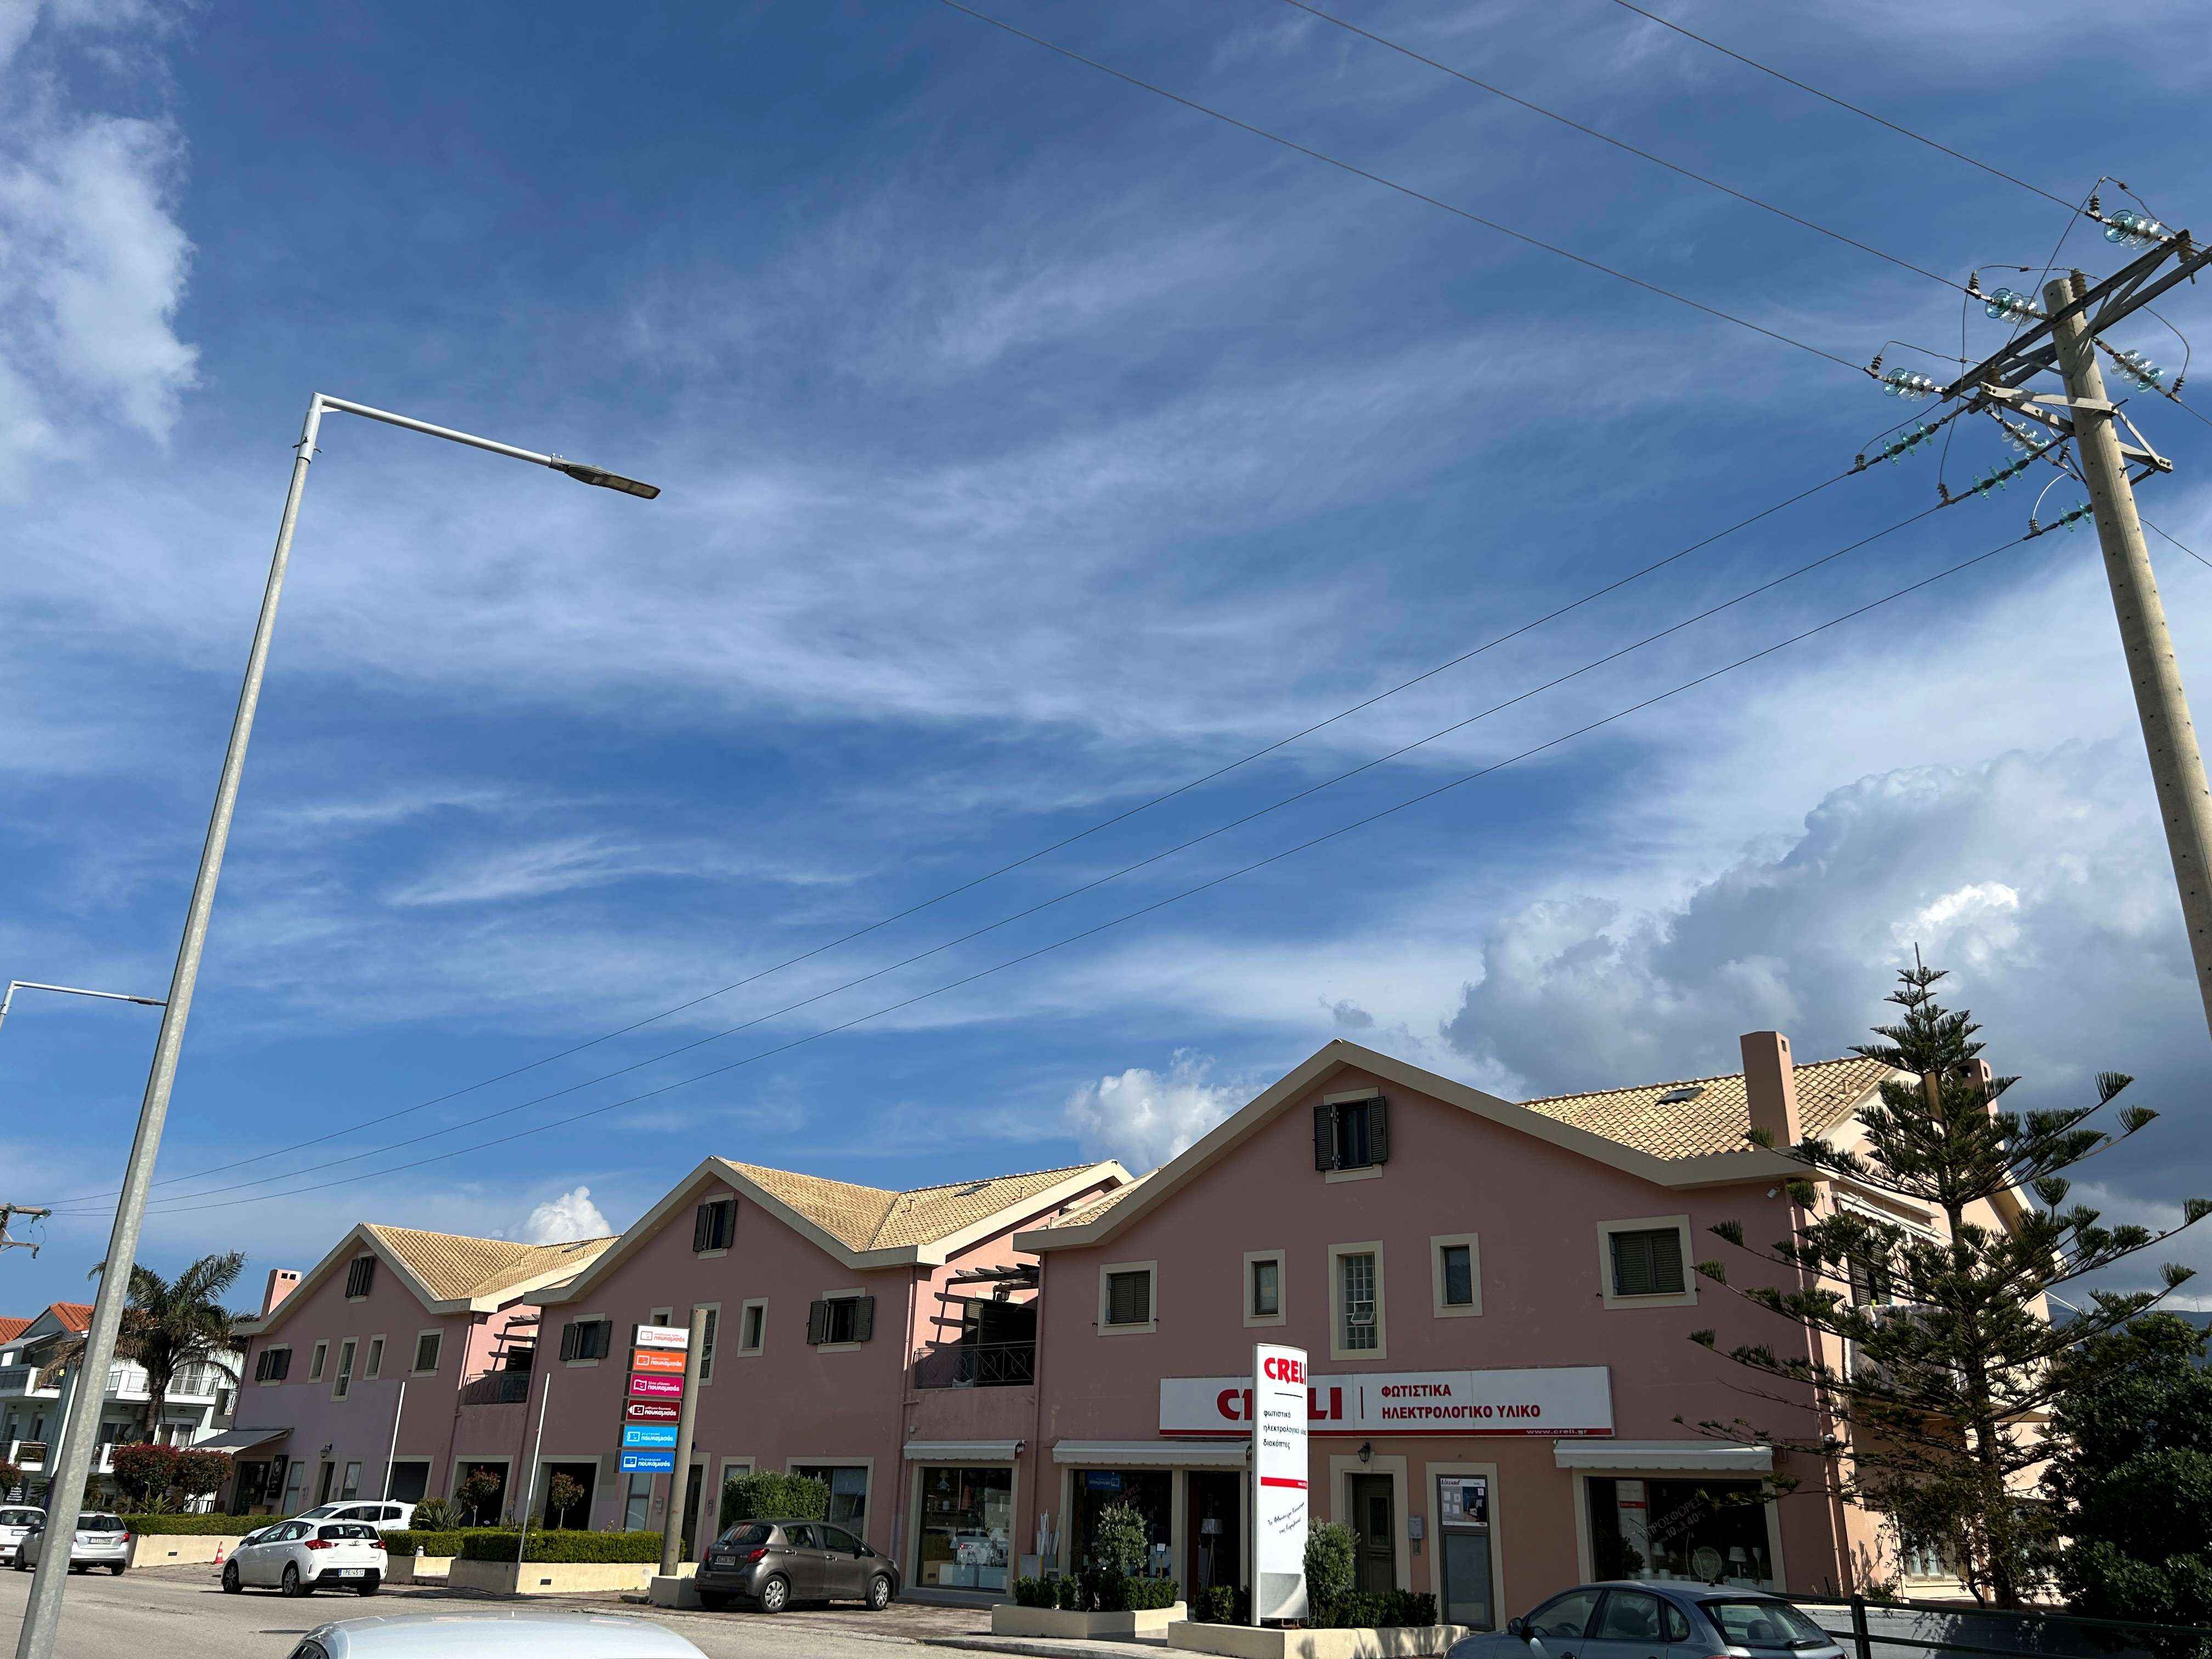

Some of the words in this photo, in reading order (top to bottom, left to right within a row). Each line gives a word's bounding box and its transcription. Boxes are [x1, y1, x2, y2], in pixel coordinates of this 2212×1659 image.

[1263, 1357, 1307, 1385] CRELI
[1381, 1384, 1452, 1398] ΦΩΤΙΣΤΙΚΑ
[1217, 1387, 1342, 1420] CLI
[1263, 1410, 1291, 1418] φωτιστικά
[1382, 1404, 1493, 1419] ΗΛΕΚΤΡΟΛΟΓΙΚΟ
[1497, 1404, 1541, 1418] ΥΛΙΚΟ
[1263, 1423, 1300, 1435] ηλεκτρολογικό
[1263, 1438, 1290, 1451] διακόπτες
